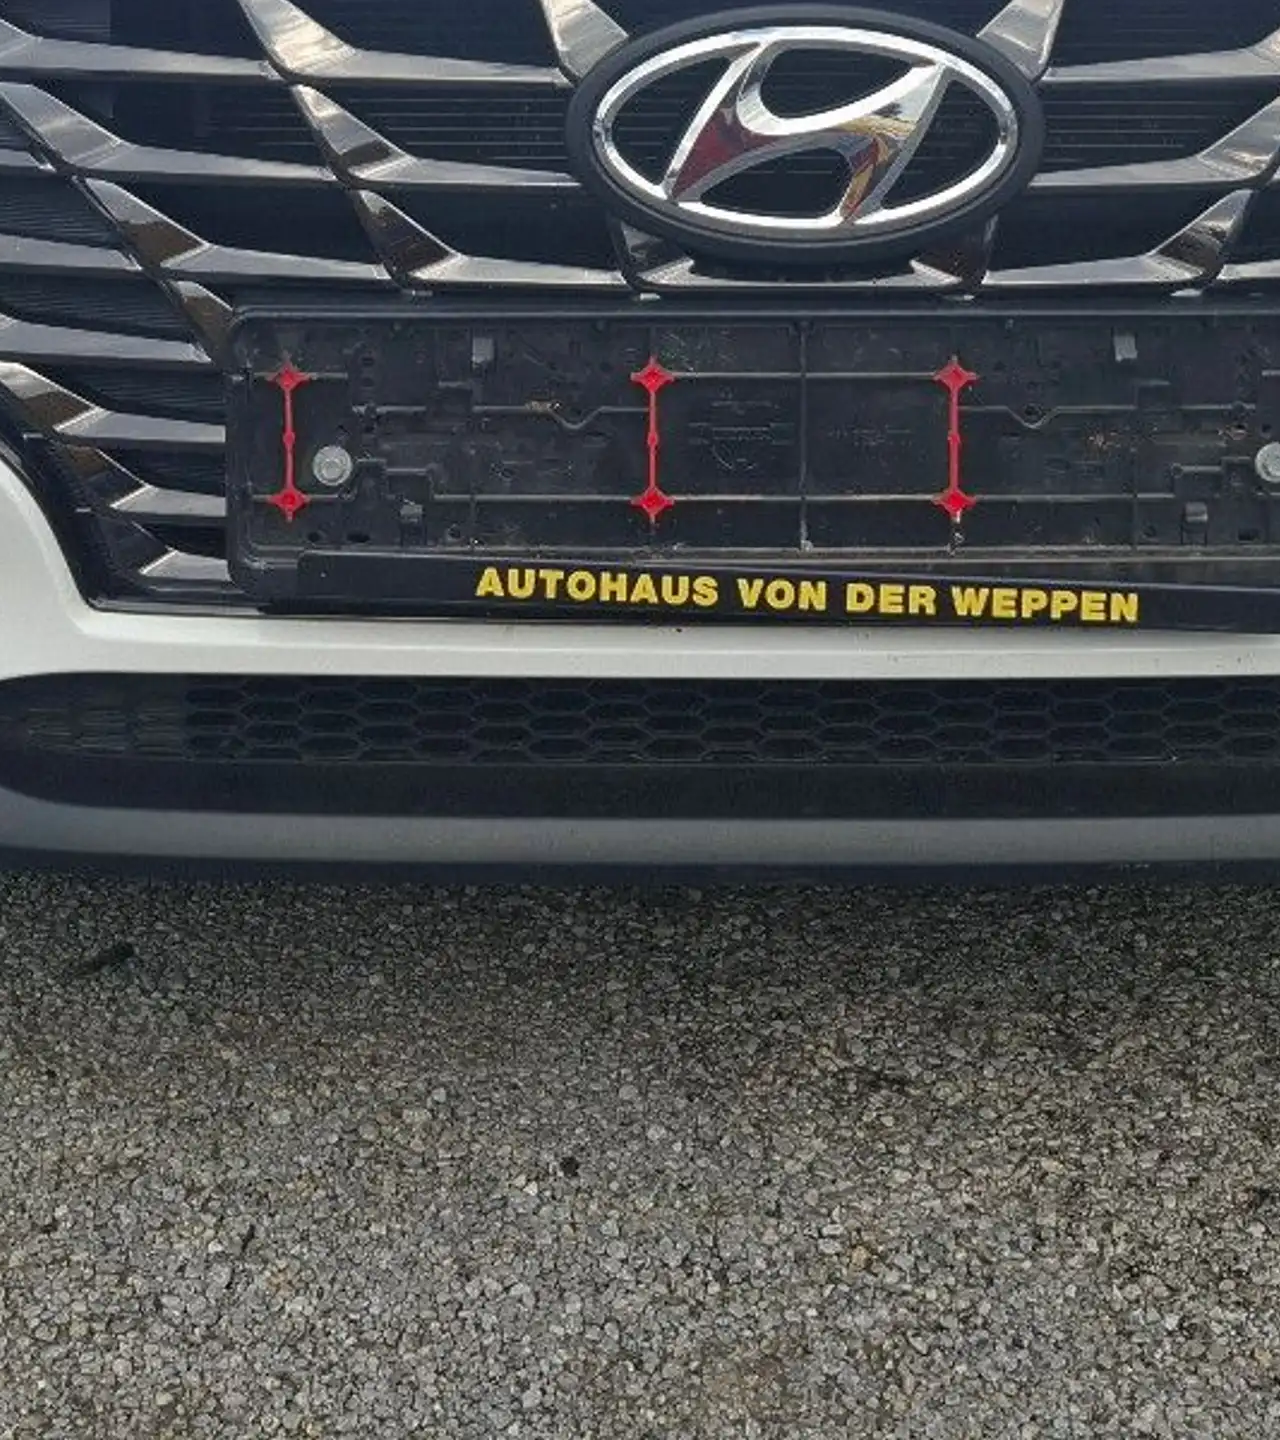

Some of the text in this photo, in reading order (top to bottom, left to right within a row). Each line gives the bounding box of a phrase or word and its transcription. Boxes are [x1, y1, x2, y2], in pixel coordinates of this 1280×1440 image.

[477, 568, 1139, 622] AUTOHAUS VON DER WEPPEN
